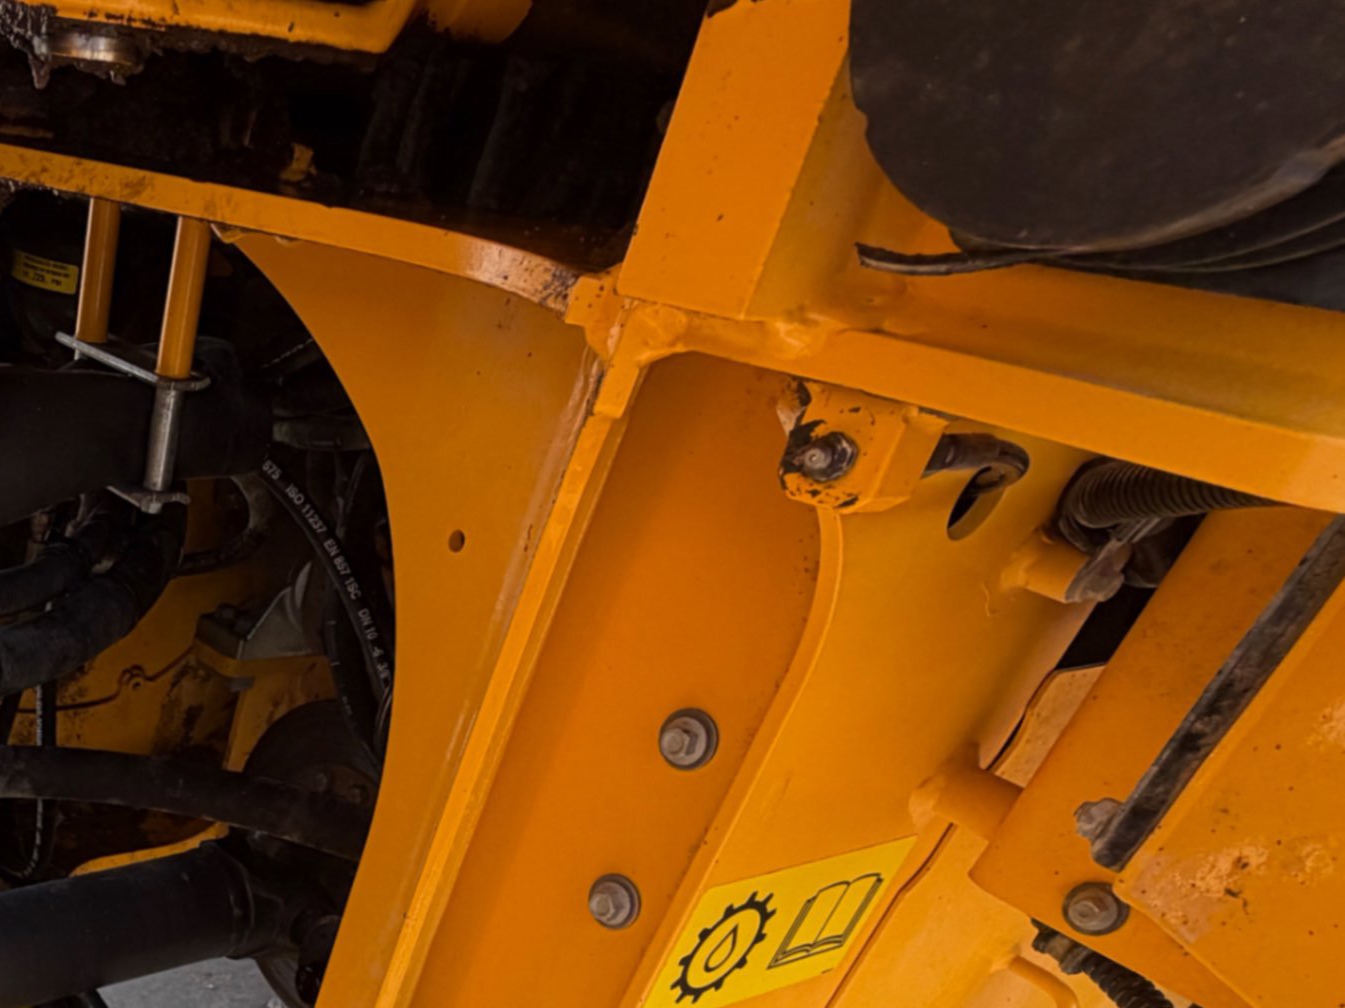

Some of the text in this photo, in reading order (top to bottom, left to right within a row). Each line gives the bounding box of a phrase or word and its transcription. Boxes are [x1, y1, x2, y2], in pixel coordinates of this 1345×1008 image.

[285, 484, 305, 505] ISO
[301, 504, 327, 533] 11237
[323, 539, 341, 557] EN
[333, 555, 352, 575] 857
[344, 577, 362, 600] 1SC
[357, 608, 373, 626] DN
[365, 626, 379, 640] 10
